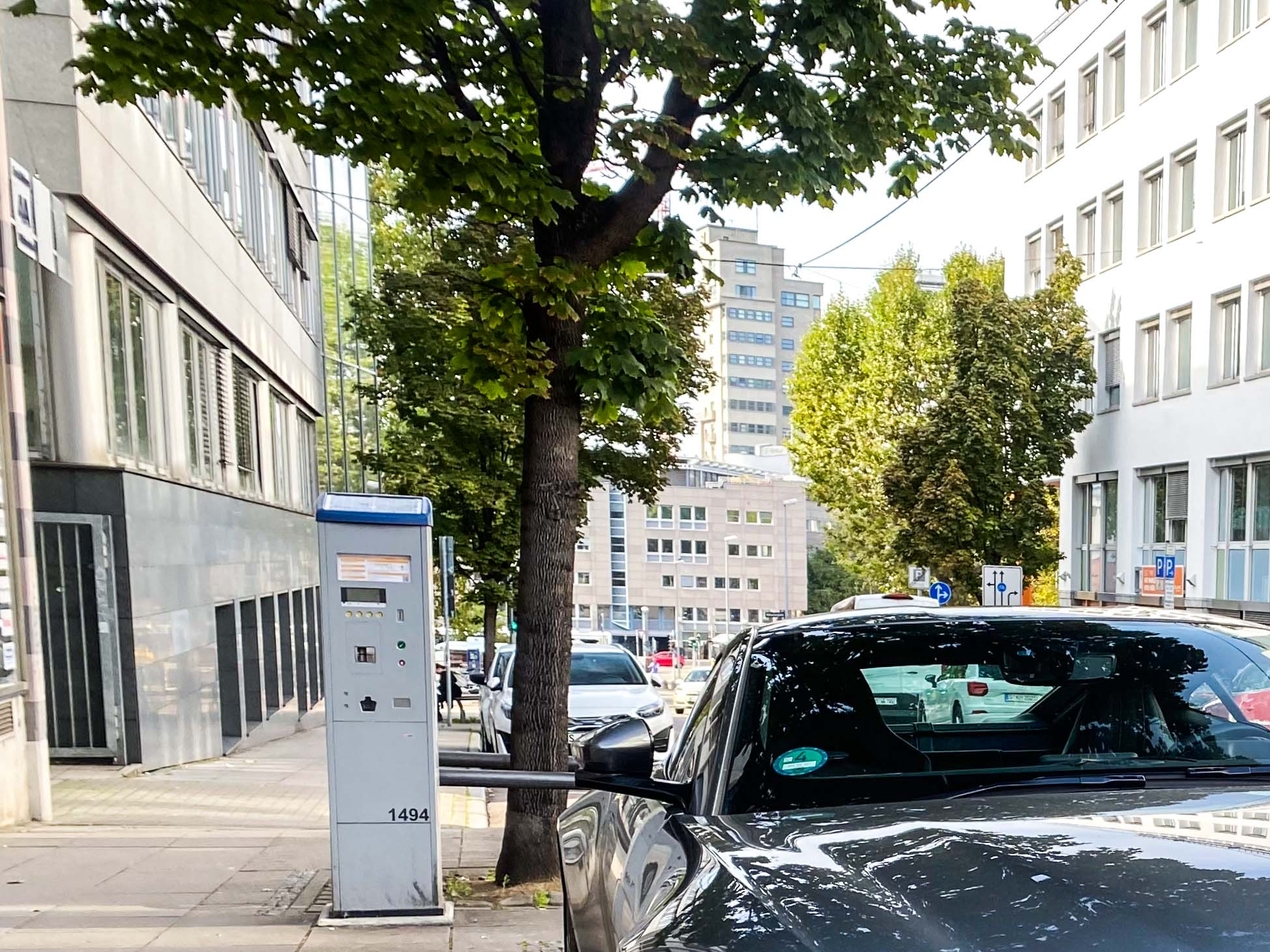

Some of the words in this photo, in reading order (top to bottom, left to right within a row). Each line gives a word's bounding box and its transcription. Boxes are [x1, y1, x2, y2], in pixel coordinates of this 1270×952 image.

[1157, 559, 1164, 576] P
[1166, 559, 1174, 576] P
[795, 751, 807, 761] 4
[388, 807, 430, 822] 1494
